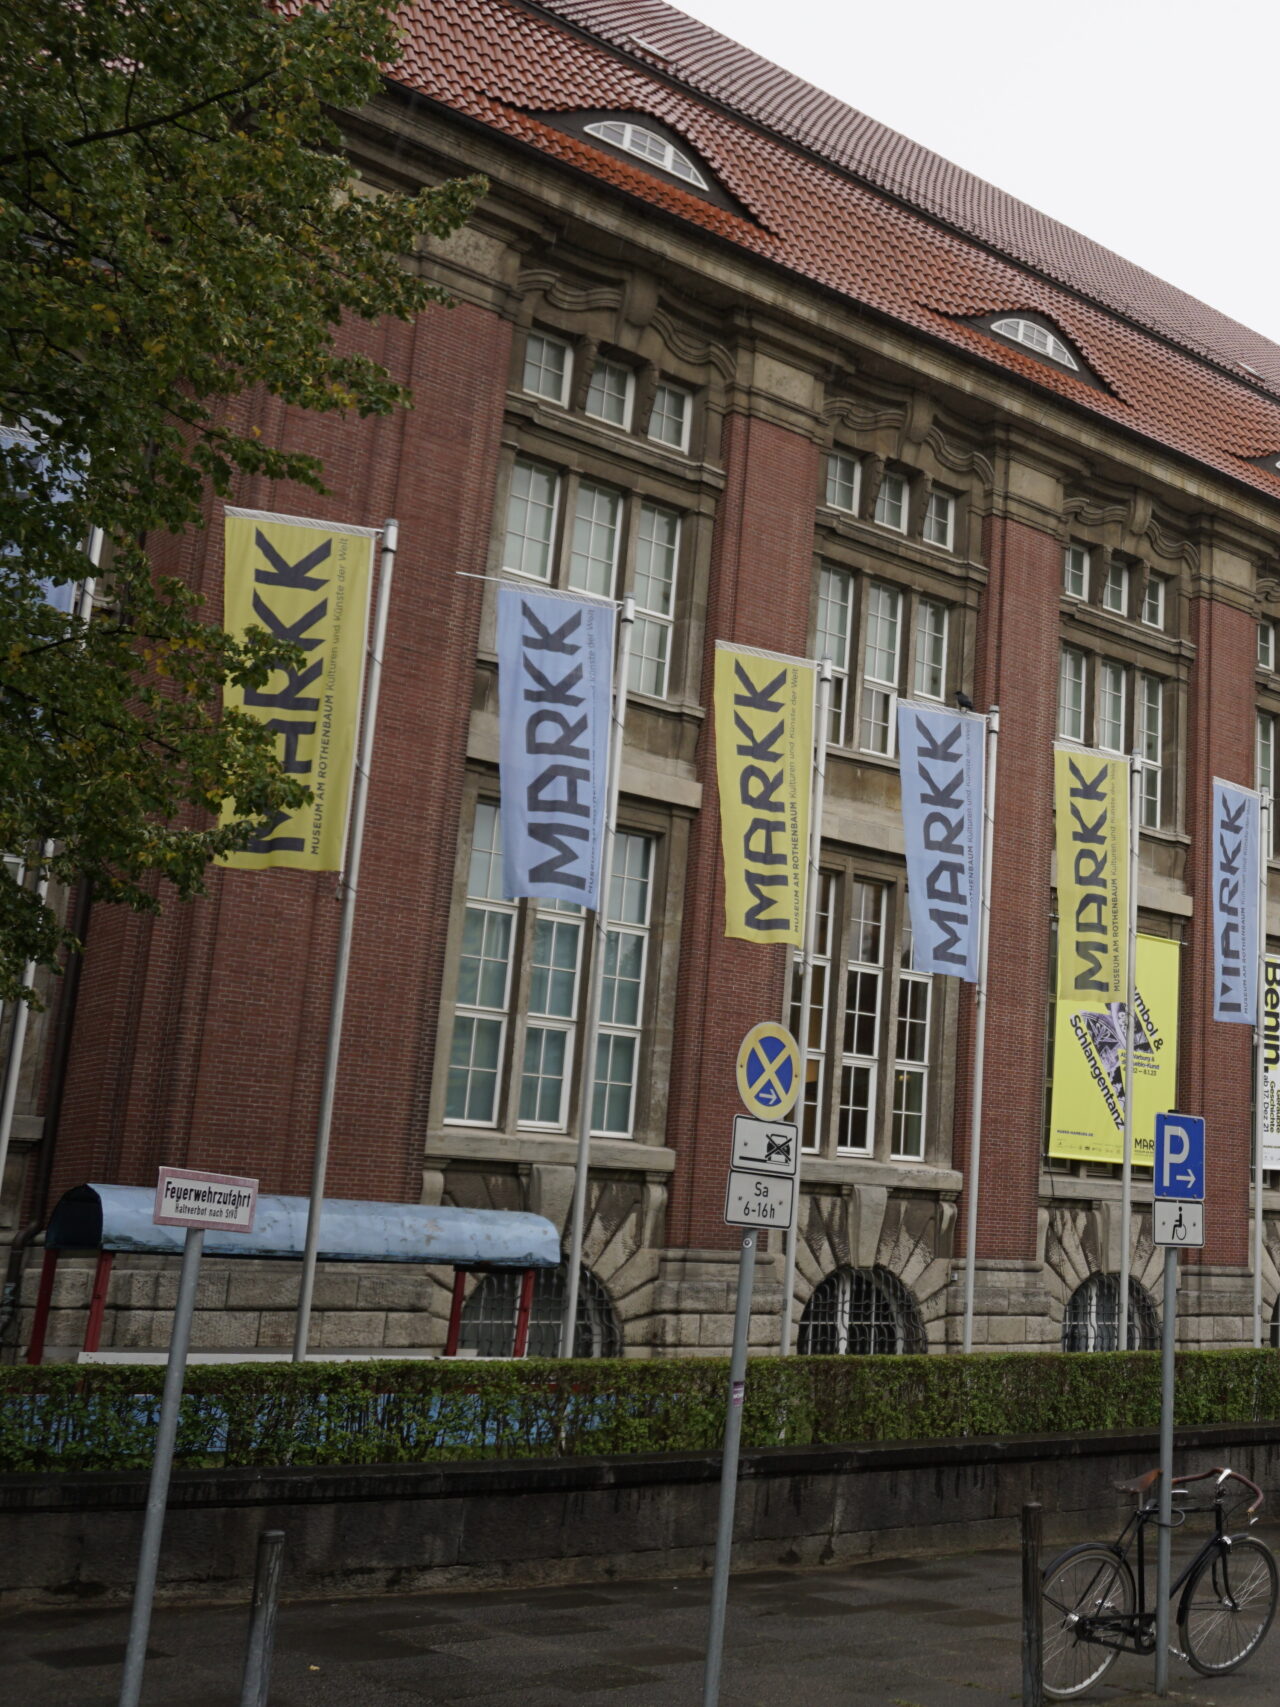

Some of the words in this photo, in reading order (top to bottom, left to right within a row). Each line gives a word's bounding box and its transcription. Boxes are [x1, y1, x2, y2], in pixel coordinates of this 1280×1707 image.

[338, 538, 349, 561] Welt
[338, 563, 346, 584] der
[334, 585, 345, 623] Künste
[332, 623, 341, 646] und
[326, 647, 339, 692] Kulturen
[318, 695, 334, 779] ROTHENBAUM
[521, 599, 590, 891] MARKK
[788, 741, 796, 759] und
[317, 782, 326, 801] AM
[734, 657, 790, 931] MARKK
[788, 762, 797, 799] Kulturen
[311, 803, 324, 855] MUSEUM
[790, 801, 800, 870] ROTHENBAUM
[915, 713, 968, 966] MARKK
[793, 872, 800, 888] AM
[967, 845, 975, 904] OTHENBAUM
[1068, 756, 1109, 992] MARKK
[791, 890, 800, 933] MUSEUM
[1111, 878, 1119, 938] ROTHENBAUM
[1112, 940, 1119, 953] AM
[1134, 985, 1159, 1036] mbol
[1154, 1038, 1164, 1052] &
[1070, 1014, 1125, 1130] Schlangentanz
[1264, 1075, 1270, 1087] ab
[1134, 1137, 1154, 1151] MAR
[1163, 1125, 1190, 1187] P
[165, 1181, 251, 1208] Feuerwehrzufahrt
[754, 1181, 769, 1198] Sa
[175, 1203, 207, 1217] Haltverbot
[208, 1208, 223, 1217] nach
[743, 1201, 775, 1219] 6-16h
